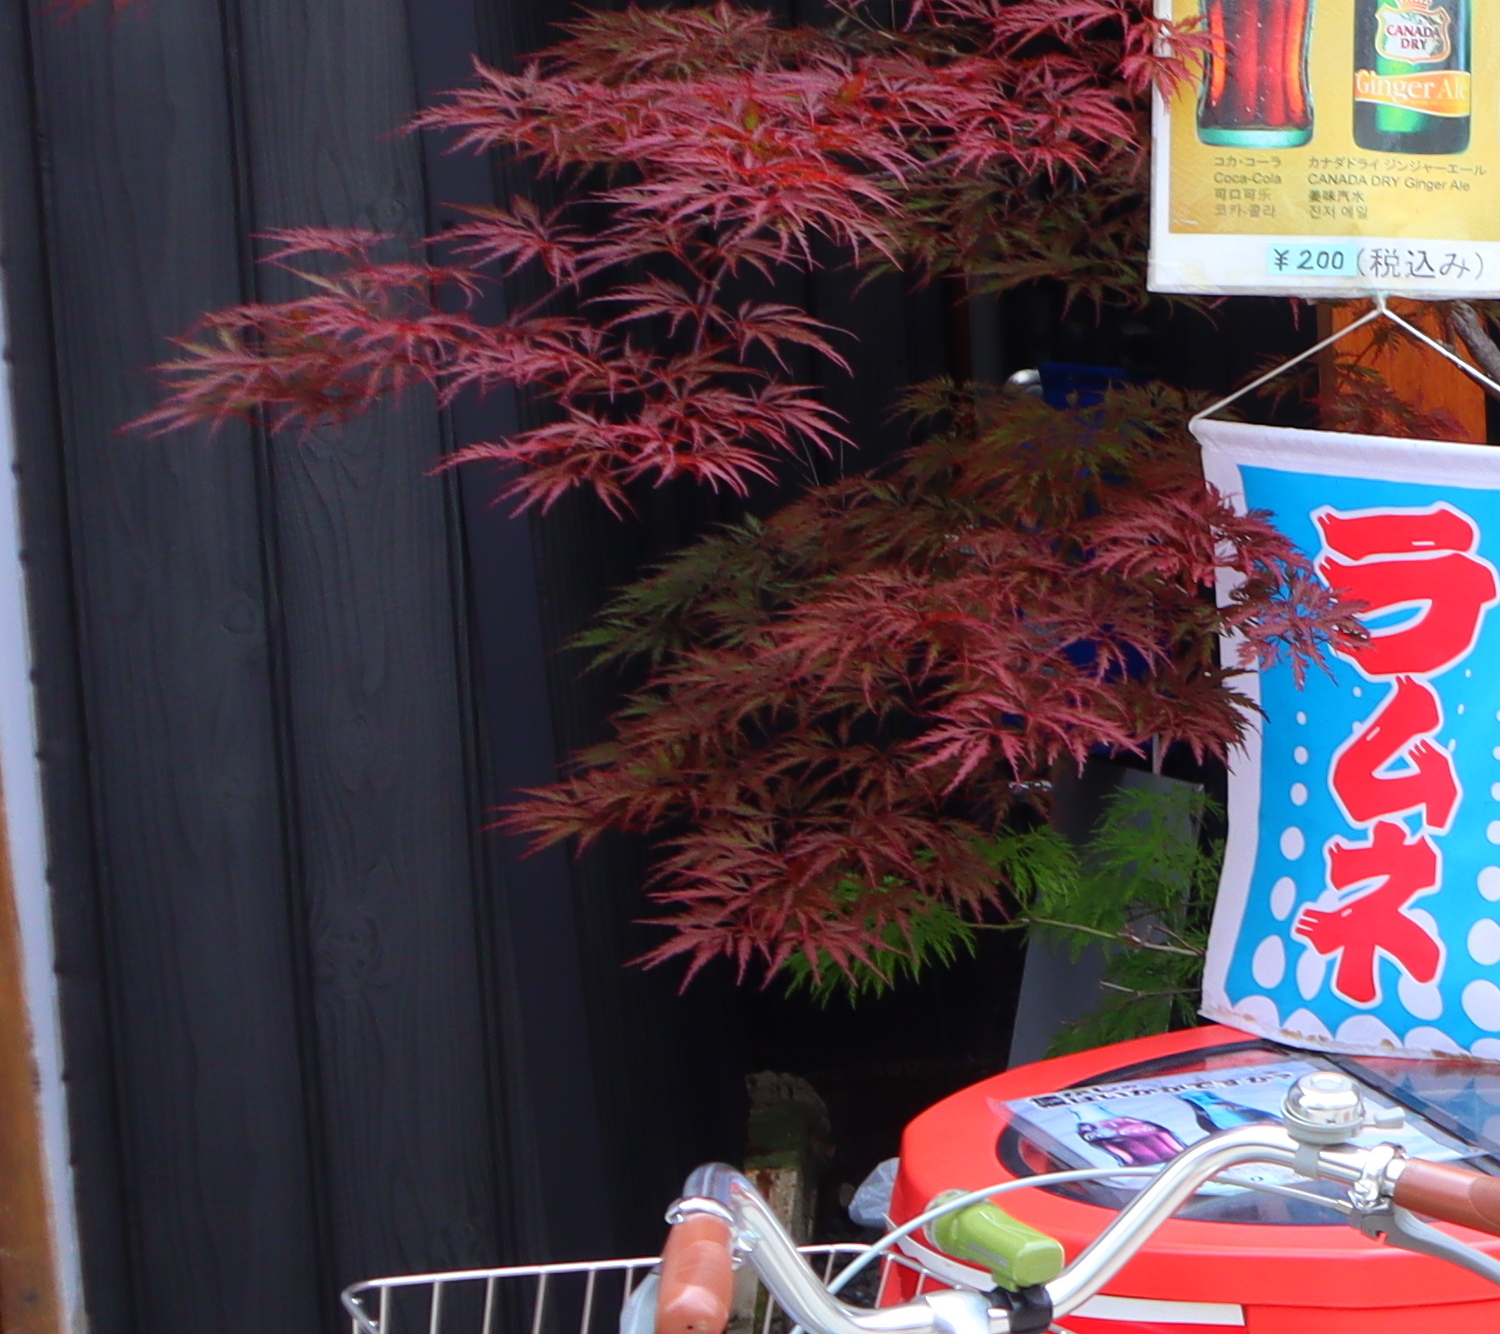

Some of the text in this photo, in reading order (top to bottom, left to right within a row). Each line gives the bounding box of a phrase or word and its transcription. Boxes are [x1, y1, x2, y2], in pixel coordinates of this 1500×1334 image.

[1386, 23, 1440, 38] CANADA
[1401, 38, 1427, 51] DRY
[1355, 71, 1436, 101] Ginger
[1214, 172, 1282, 185] Coca-Cola
[1307, 172, 1470, 192] CANADA DRY Ginger Ale
[1297, 508, 1500, 1004] ラムネ
